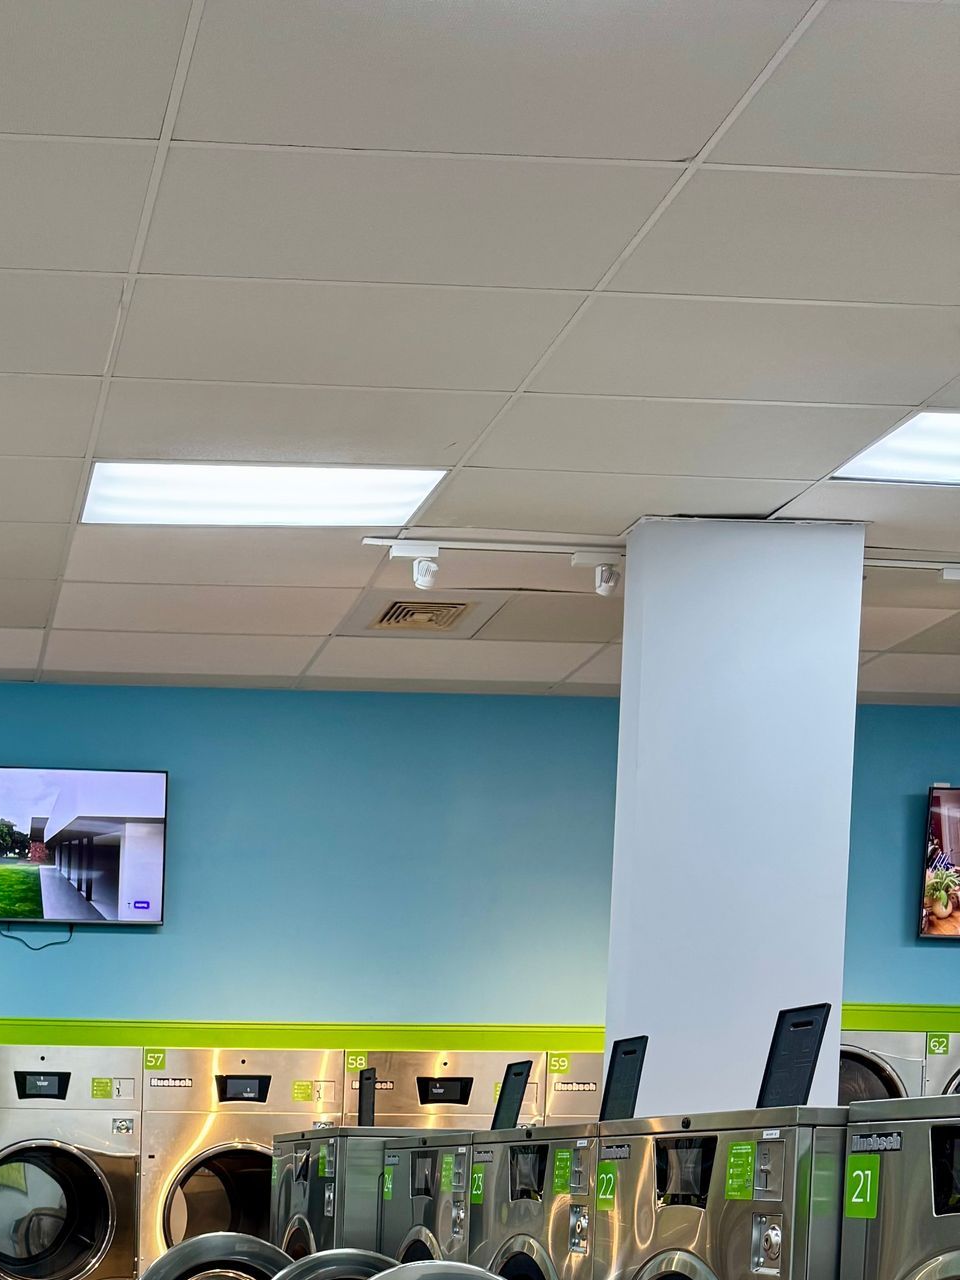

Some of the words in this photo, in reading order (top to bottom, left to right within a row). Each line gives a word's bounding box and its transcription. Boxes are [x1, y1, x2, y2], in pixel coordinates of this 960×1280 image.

[930, 1038, 947, 1050] 62
[146, 1053, 164, 1066] 57
[347, 1056, 366, 1068] 58
[550, 1057, 568, 1070] 59
[150, 1078, 192, 1087] Huebsch
[384, 1174, 392, 1192] 24
[472, 1173, 483, 1194] 23
[599, 1173, 614, 1199] 22
[851, 1170, 872, 1203] 21
